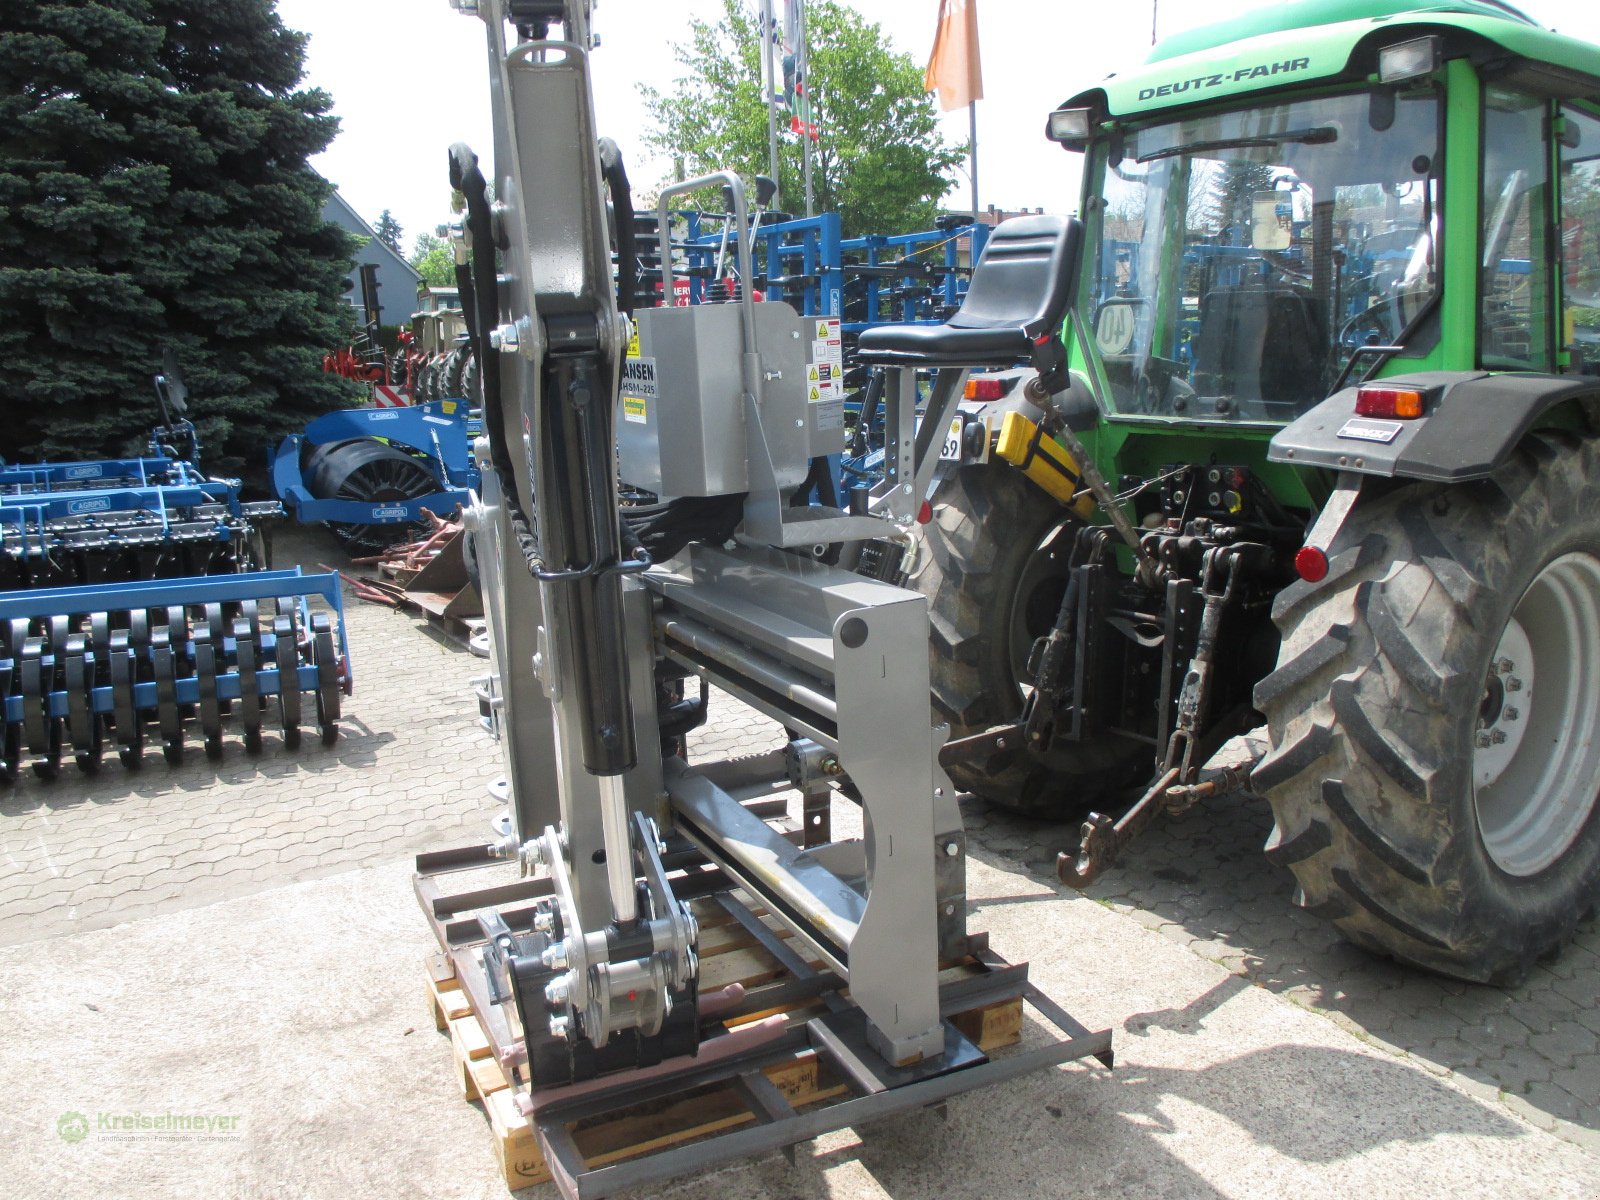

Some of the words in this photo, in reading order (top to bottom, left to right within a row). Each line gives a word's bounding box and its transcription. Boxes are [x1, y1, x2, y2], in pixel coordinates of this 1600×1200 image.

[1138, 57, 1310, 101] DEUTZ-FAHR
[623, 363, 654, 381] ANSEN
[620, 382, 655, 394] HSM-225
